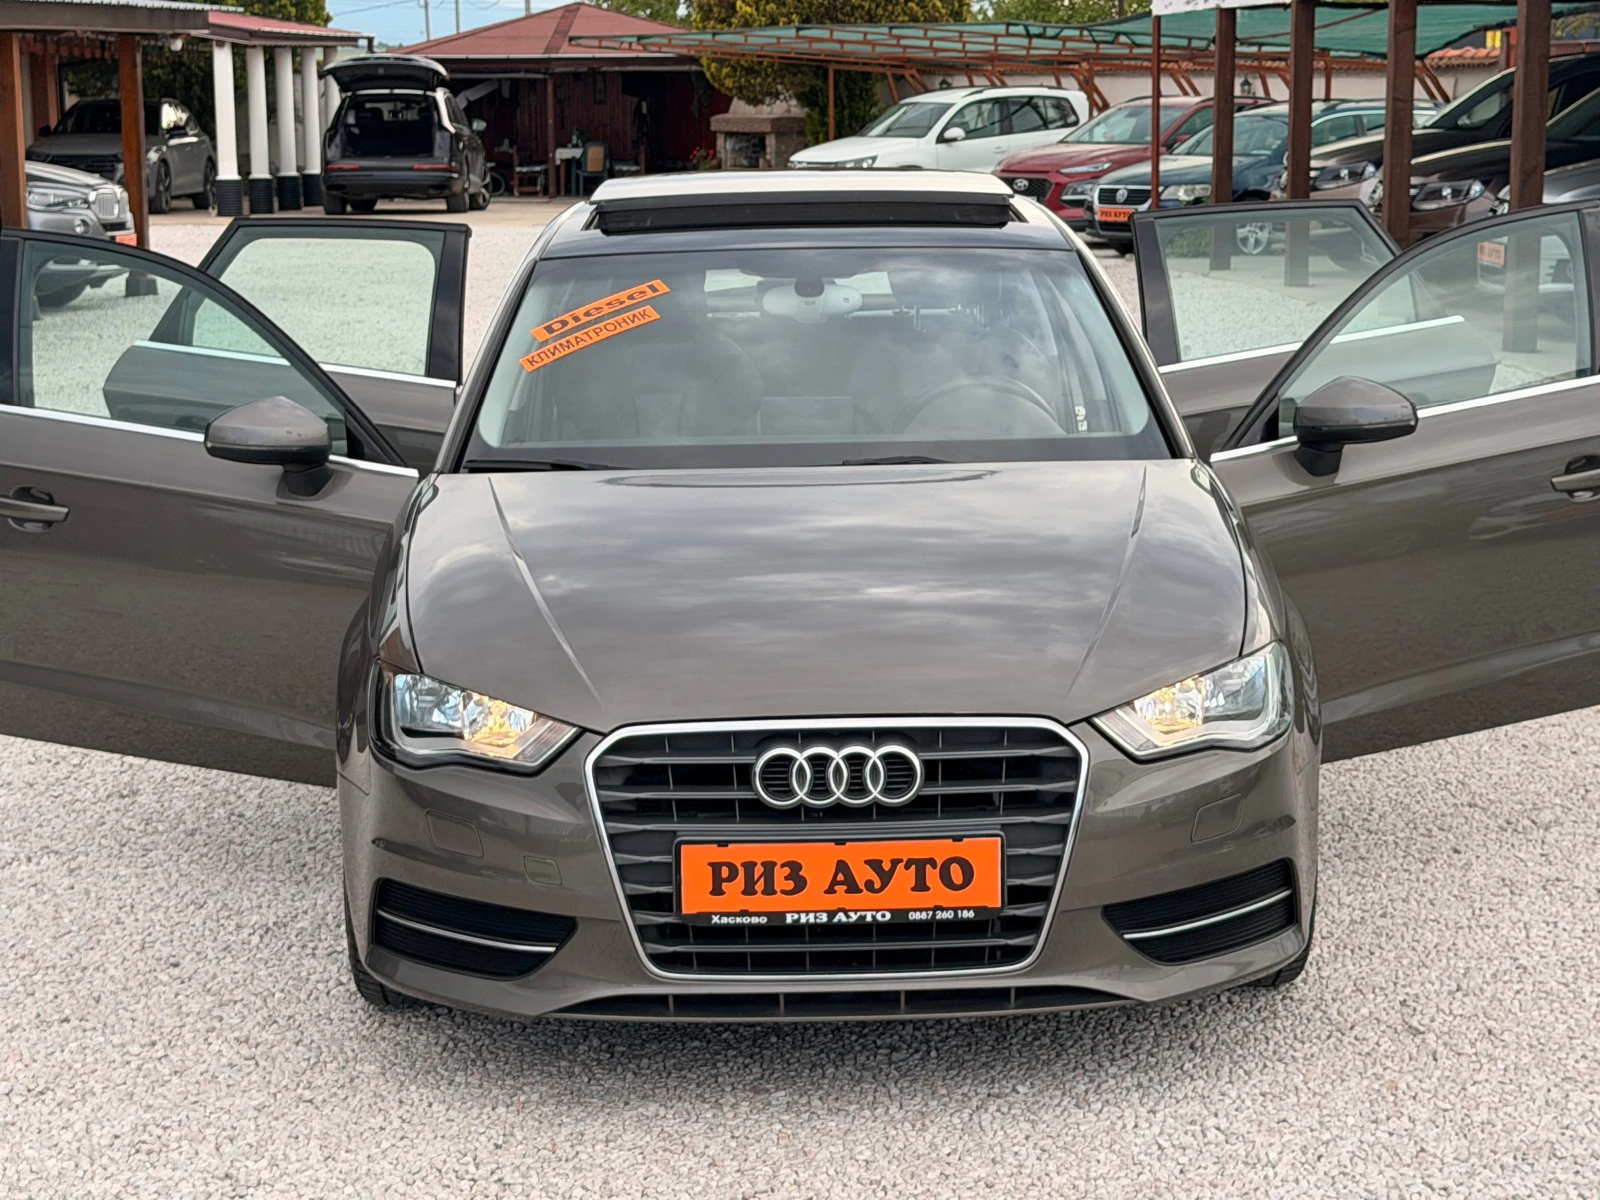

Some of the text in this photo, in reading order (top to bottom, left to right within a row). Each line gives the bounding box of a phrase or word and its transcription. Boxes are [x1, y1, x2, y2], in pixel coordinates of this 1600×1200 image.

[543, 284, 660, 335] Diesel
[526, 309, 652, 367] КЛИМАТРОНИК
[707, 856, 975, 897] РИЗ АУТО
[711, 914, 768, 925] Хасково
[785, 910, 892, 924] РИЗ АУТО
[908, 909, 975, 921] 0887 260 186
